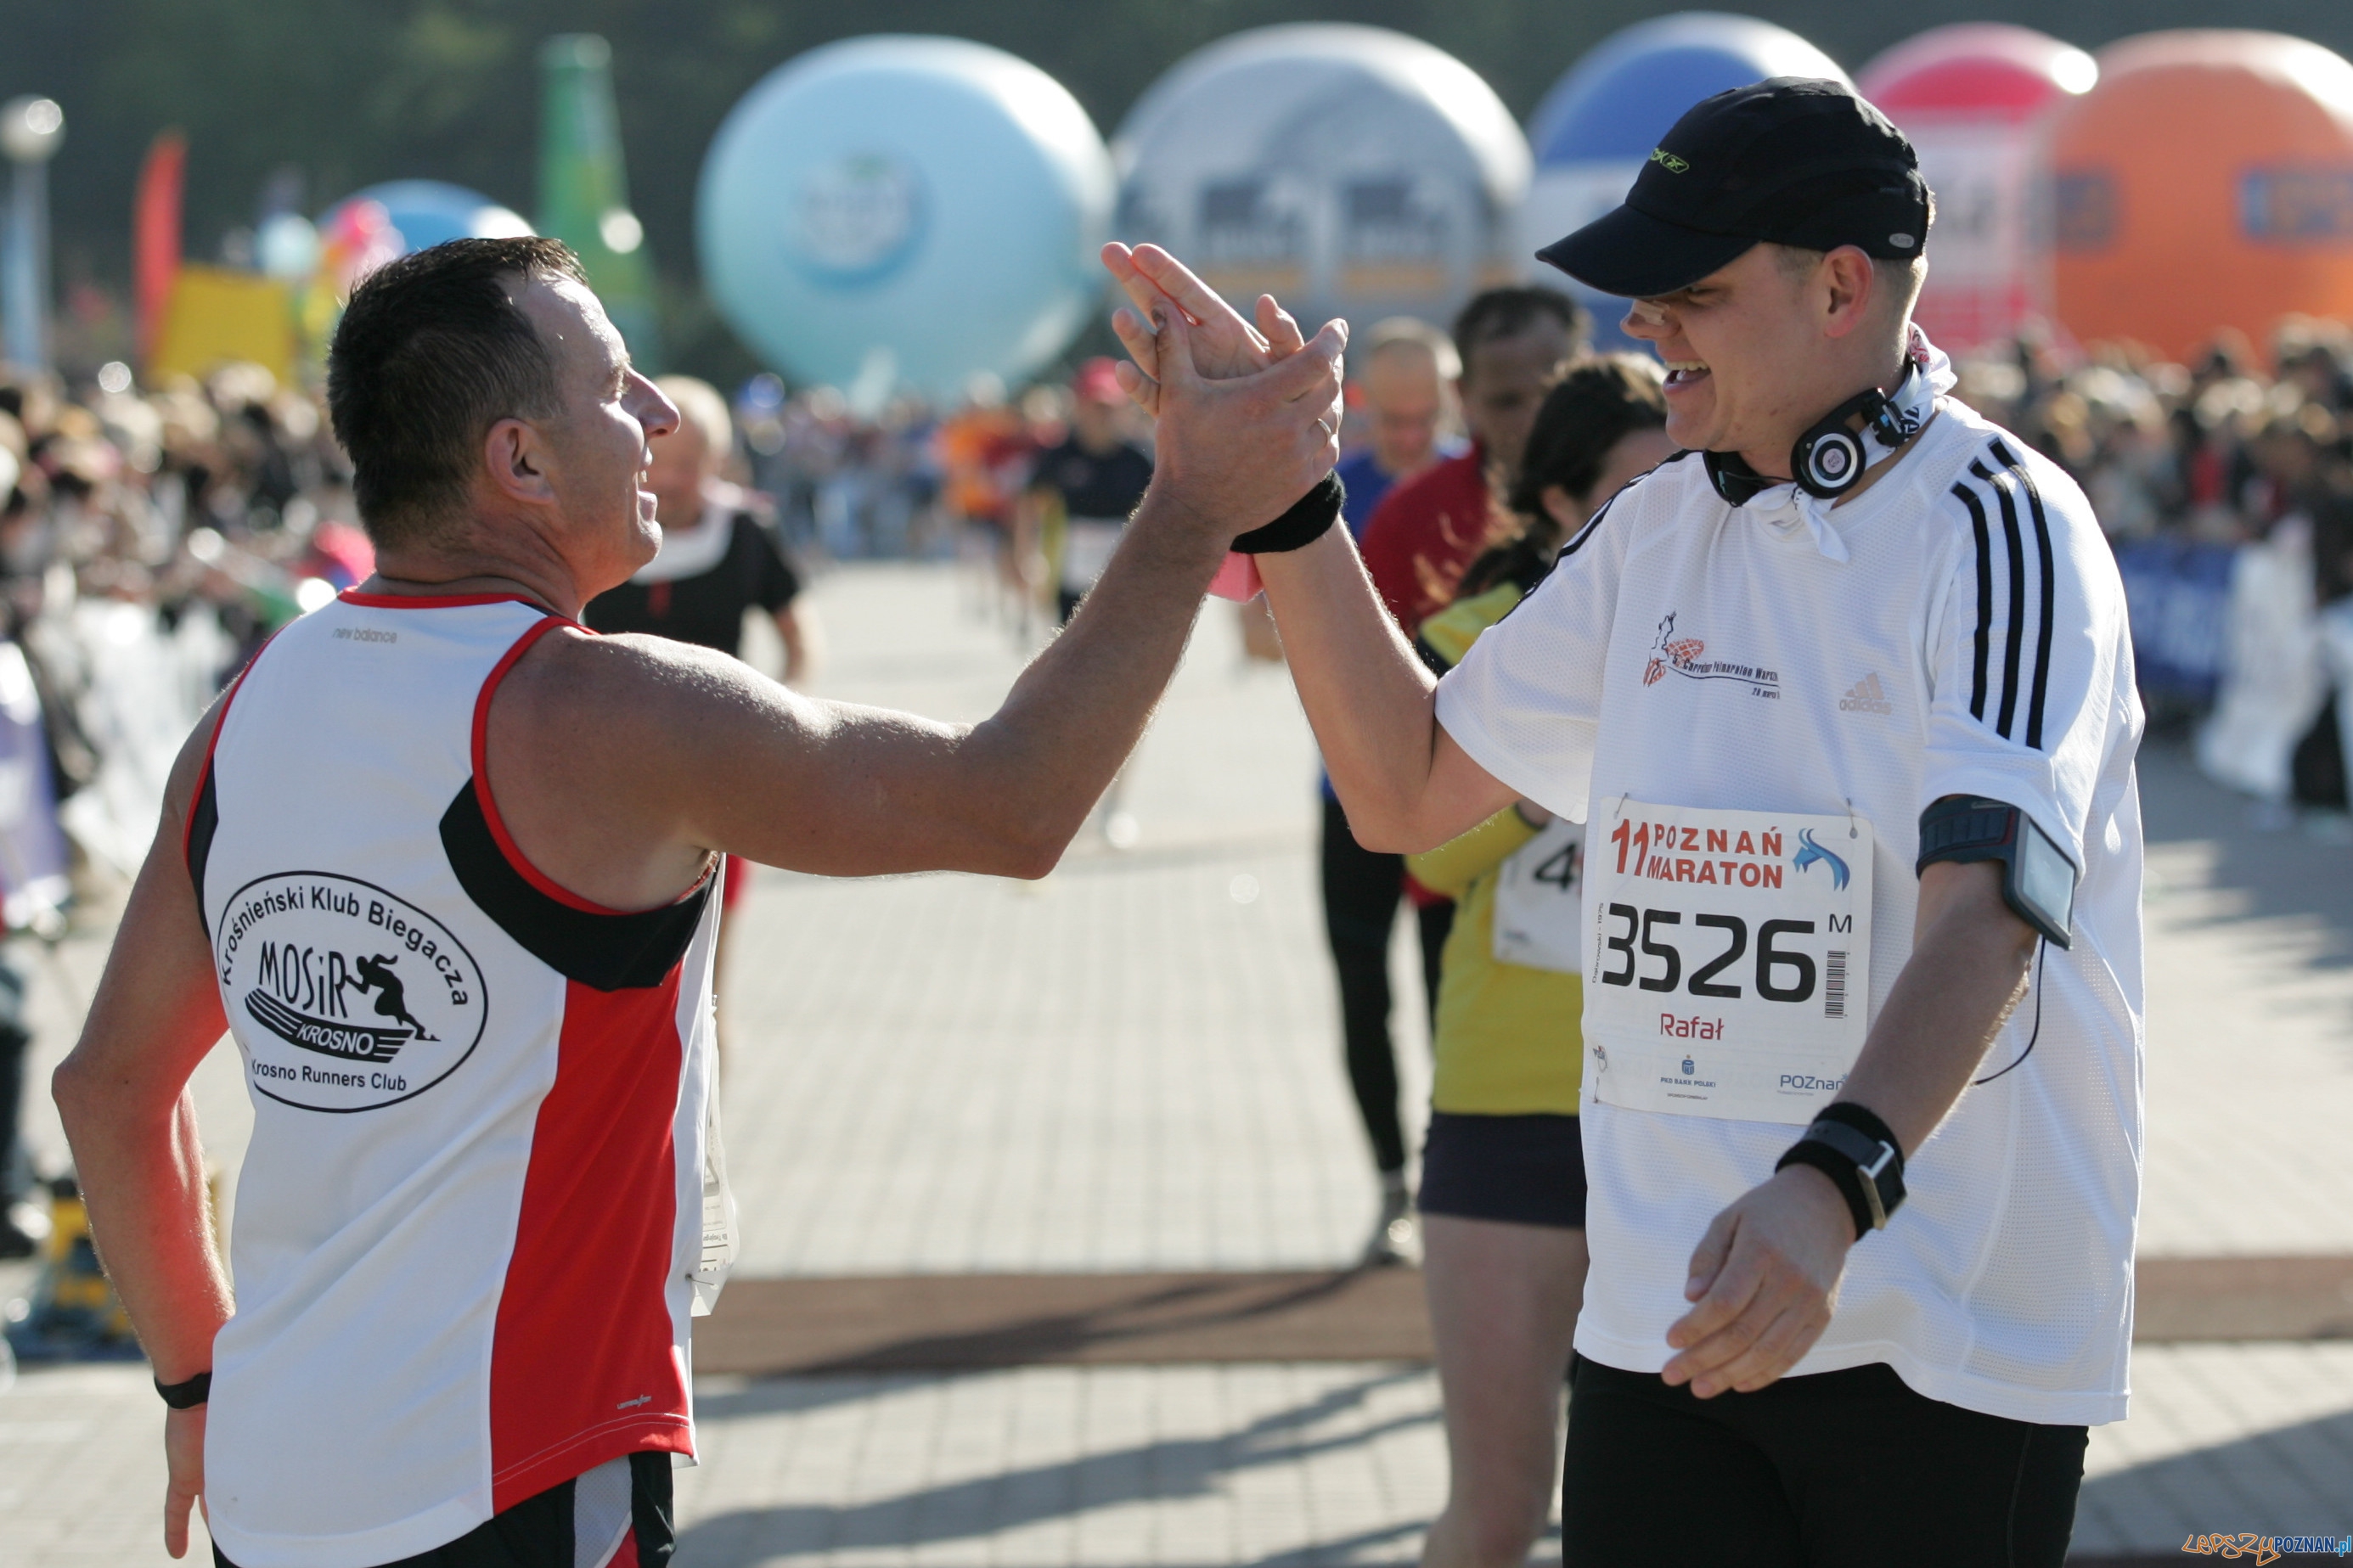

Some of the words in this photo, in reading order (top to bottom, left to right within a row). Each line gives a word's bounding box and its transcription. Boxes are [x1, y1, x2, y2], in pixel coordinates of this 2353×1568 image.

[353, 627, 397, 643] balance
[1839, 696, 1891, 715] adidas
[1611, 818, 1649, 877] 11
[1654, 823, 1782, 857] POZNAŃ
[1647, 855, 1782, 889] MARATON
[1829, 913, 1852, 934] M
[222, 885, 304, 986] Krośnieński
[311, 885, 360, 917] Klub
[368, 900, 469, 1006] Biegacza
[1602, 902, 1815, 1003] 3526
[259, 941, 348, 1018] MOSiR
[296, 1023, 374, 1055] KROSNO
[1660, 1013, 1725, 1040] Rafał
[302, 1065, 366, 1087] Runners
[371, 1072, 407, 1092] Club
